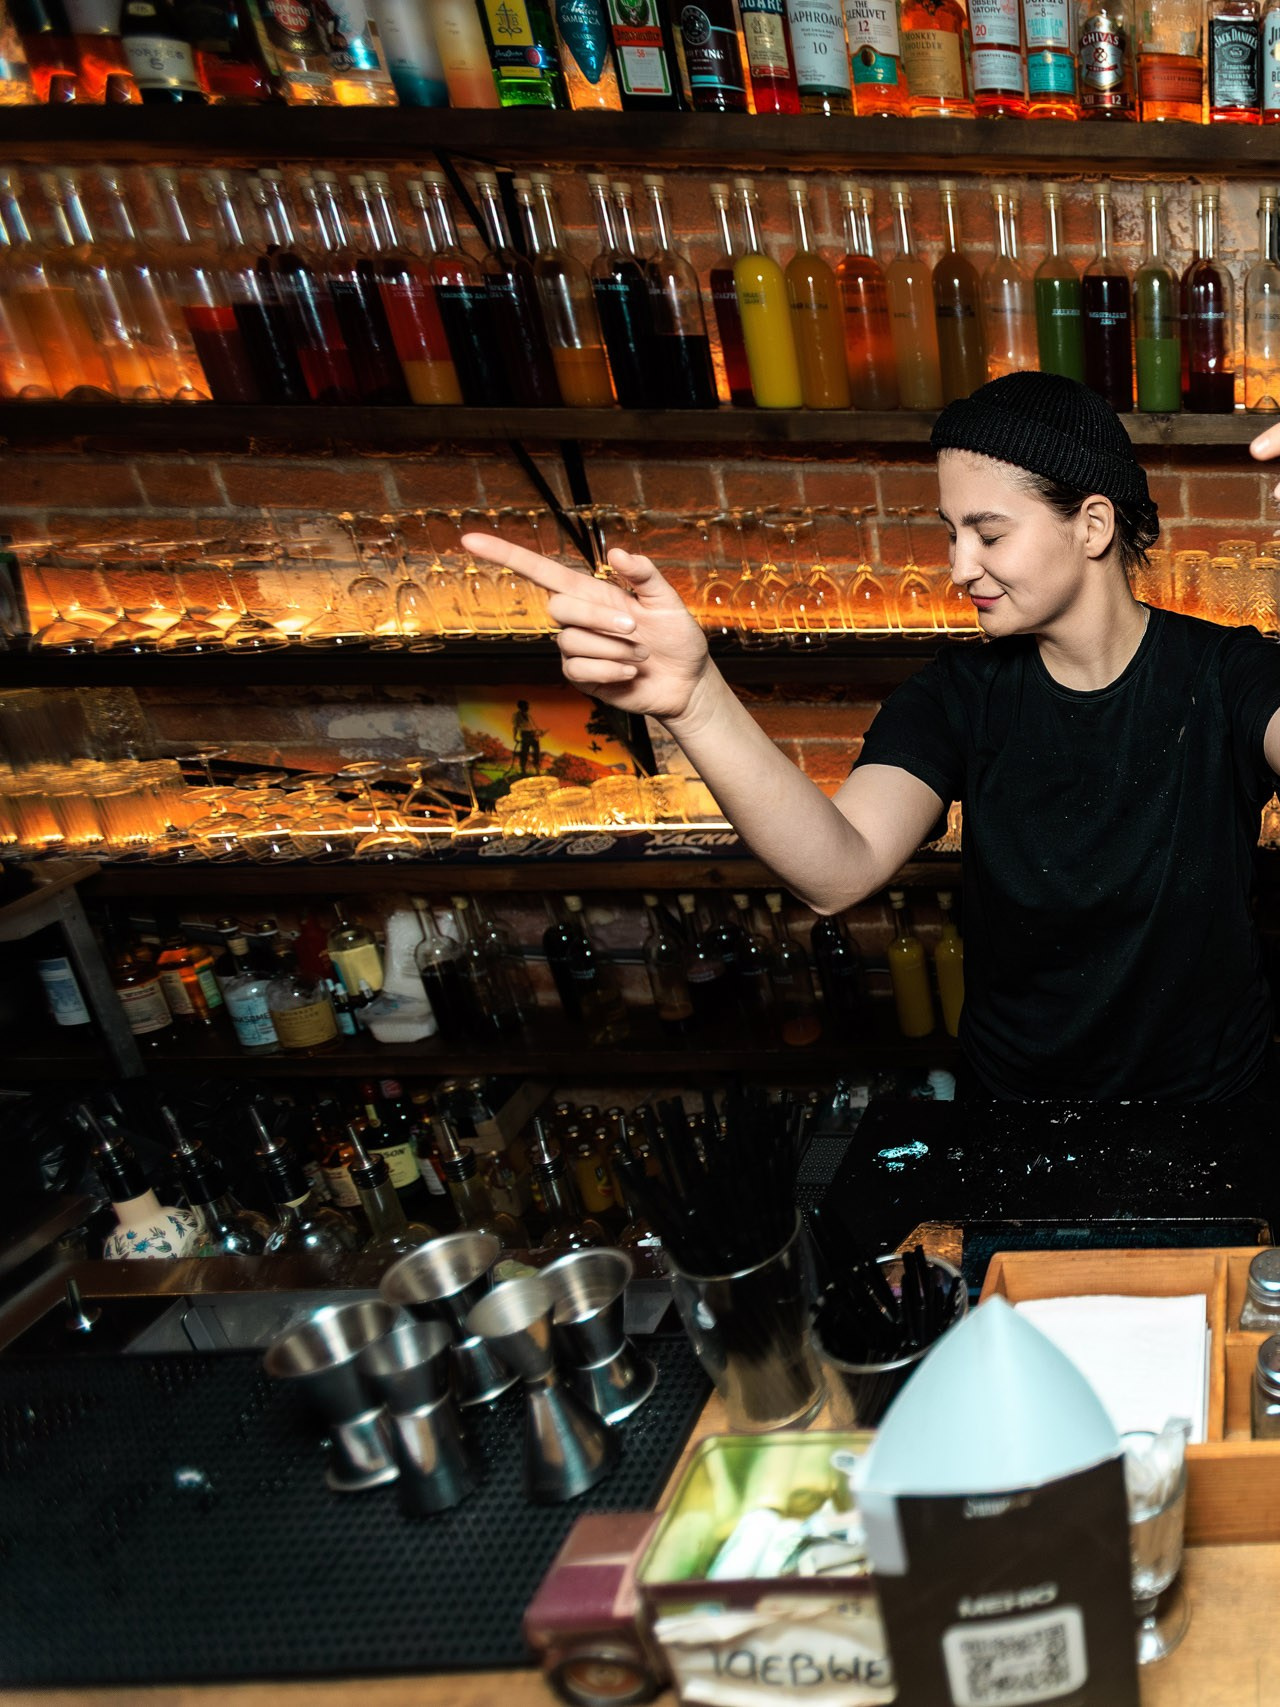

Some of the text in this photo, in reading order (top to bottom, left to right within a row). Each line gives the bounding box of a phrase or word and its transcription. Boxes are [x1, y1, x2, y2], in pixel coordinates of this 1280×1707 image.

[855, 1, 868, 9] THE
[972, 6, 1001, 14] VATORY
[846, 8, 886, 20] GLENLIVET
[1041, 7, 1047, 17] 8
[281, 14, 306, 28] Club
[858, 20, 870, 32] 12
[905, 31, 937, 41] MONKEY
[975, 25, 987, 36] 20
[1082, 32, 1119, 45] CHIVAS
[1214, 32, 1233, 48] JACK
[813, 41, 828, 55] 10
[1083, 95, 1095, 105] XII
[1111, 94, 1122, 105] 12
[645, 832, 739, 846] ХАСКИ
[957, 1581, 1059, 1619] МЕНЮ
